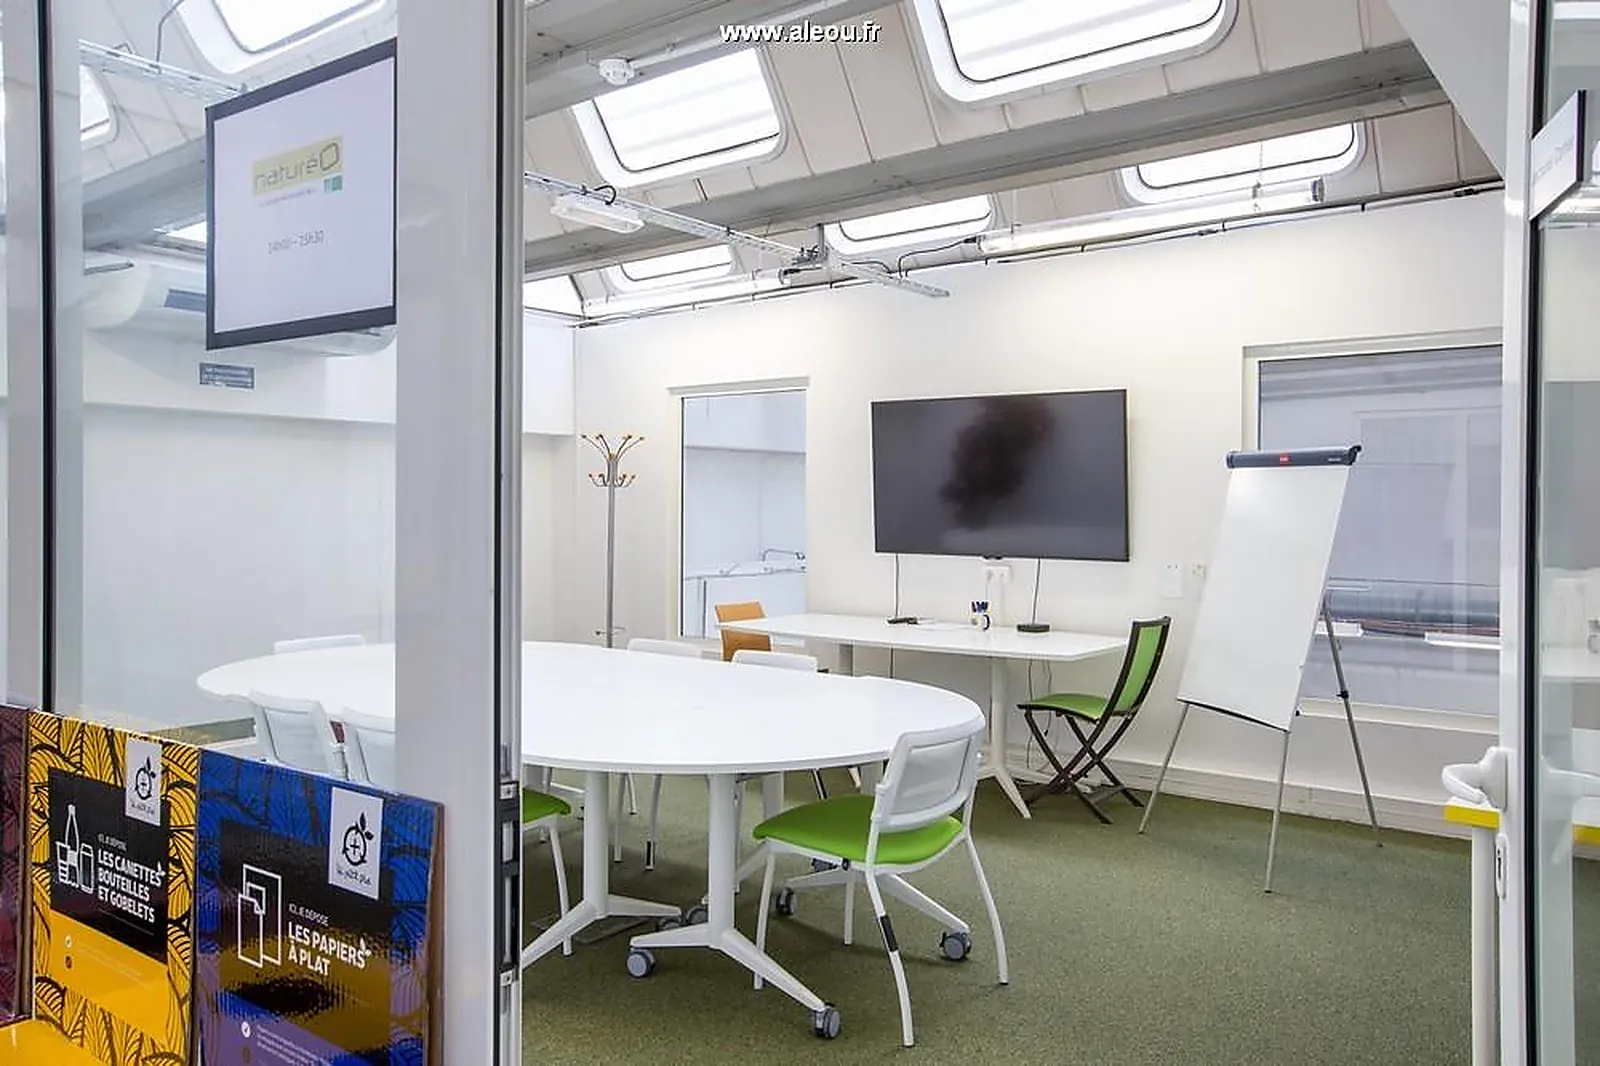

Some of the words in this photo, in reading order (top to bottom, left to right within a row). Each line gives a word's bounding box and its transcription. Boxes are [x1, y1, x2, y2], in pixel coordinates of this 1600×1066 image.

[98, 848, 114, 869] LES
[115, 856, 161, 887] CANETTES
[98, 867, 149, 902] BOUTEILLES
[98, 885, 109, 902] ET
[110, 890, 155, 923] GOBELETS
[288, 921, 310, 946] LES
[312, 931, 366, 969] PAPIERS
[288, 940, 298, 963] À
[300, 948, 330, 976] PLAT
